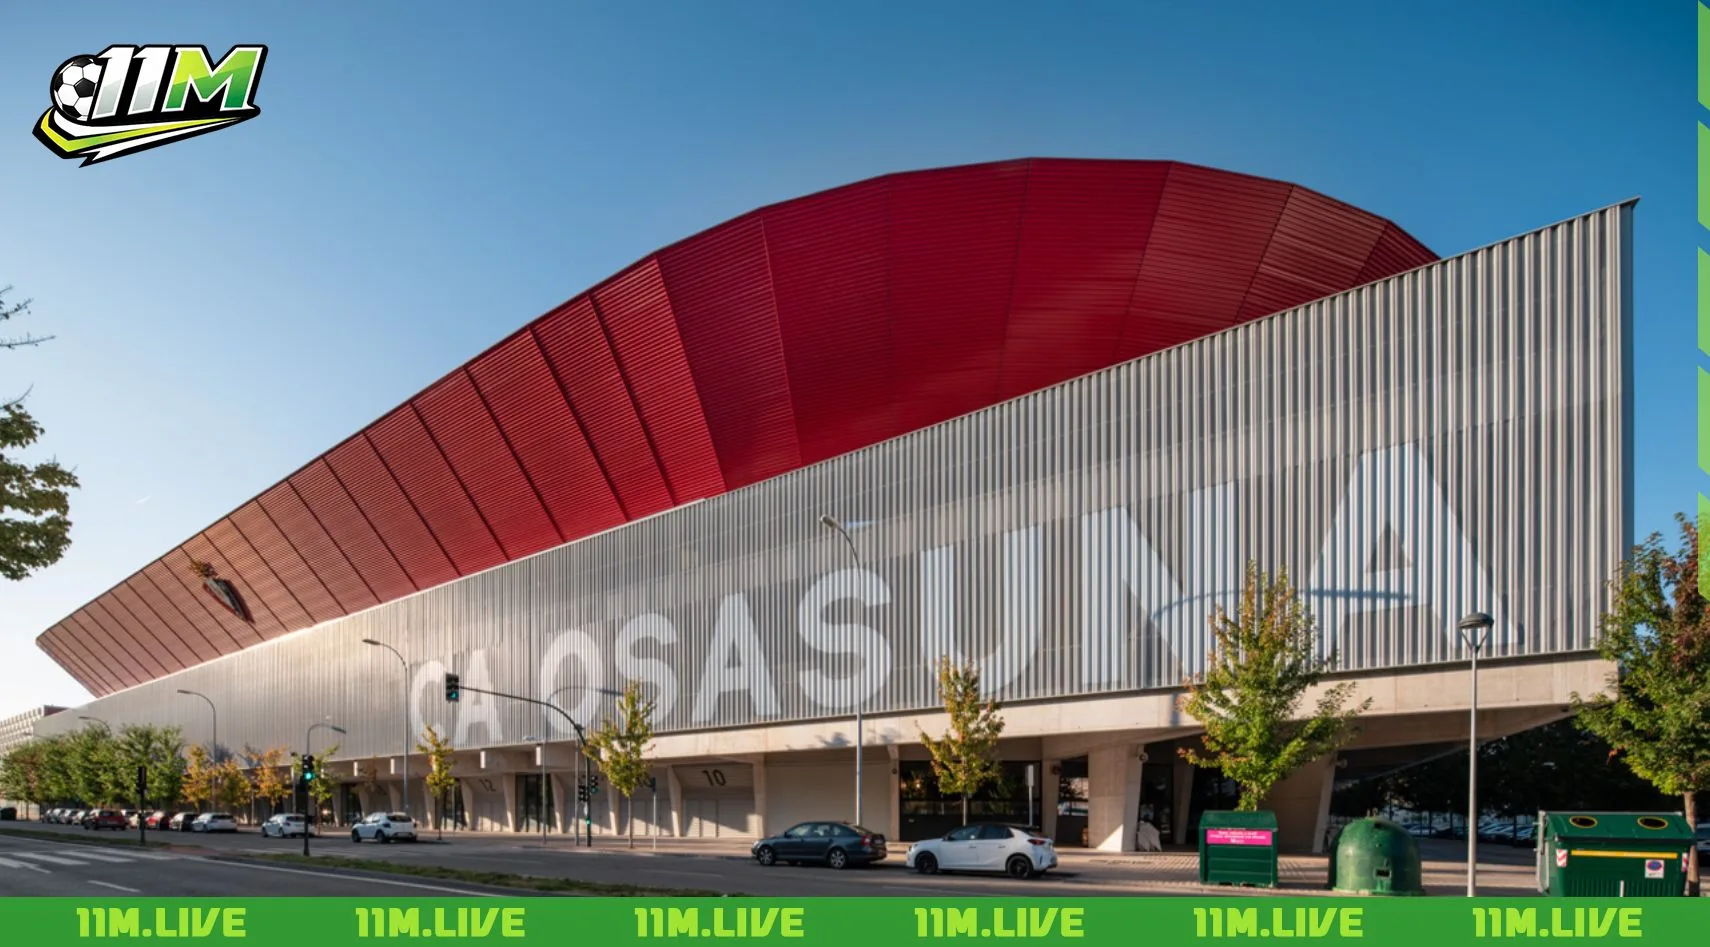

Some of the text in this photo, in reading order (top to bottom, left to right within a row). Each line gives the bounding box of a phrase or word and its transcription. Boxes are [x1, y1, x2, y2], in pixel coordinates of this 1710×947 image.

[410, 443, 1524, 746] CA OSASUNA
[479, 778, 497, 792] 12
[701, 769, 727, 787] 10
